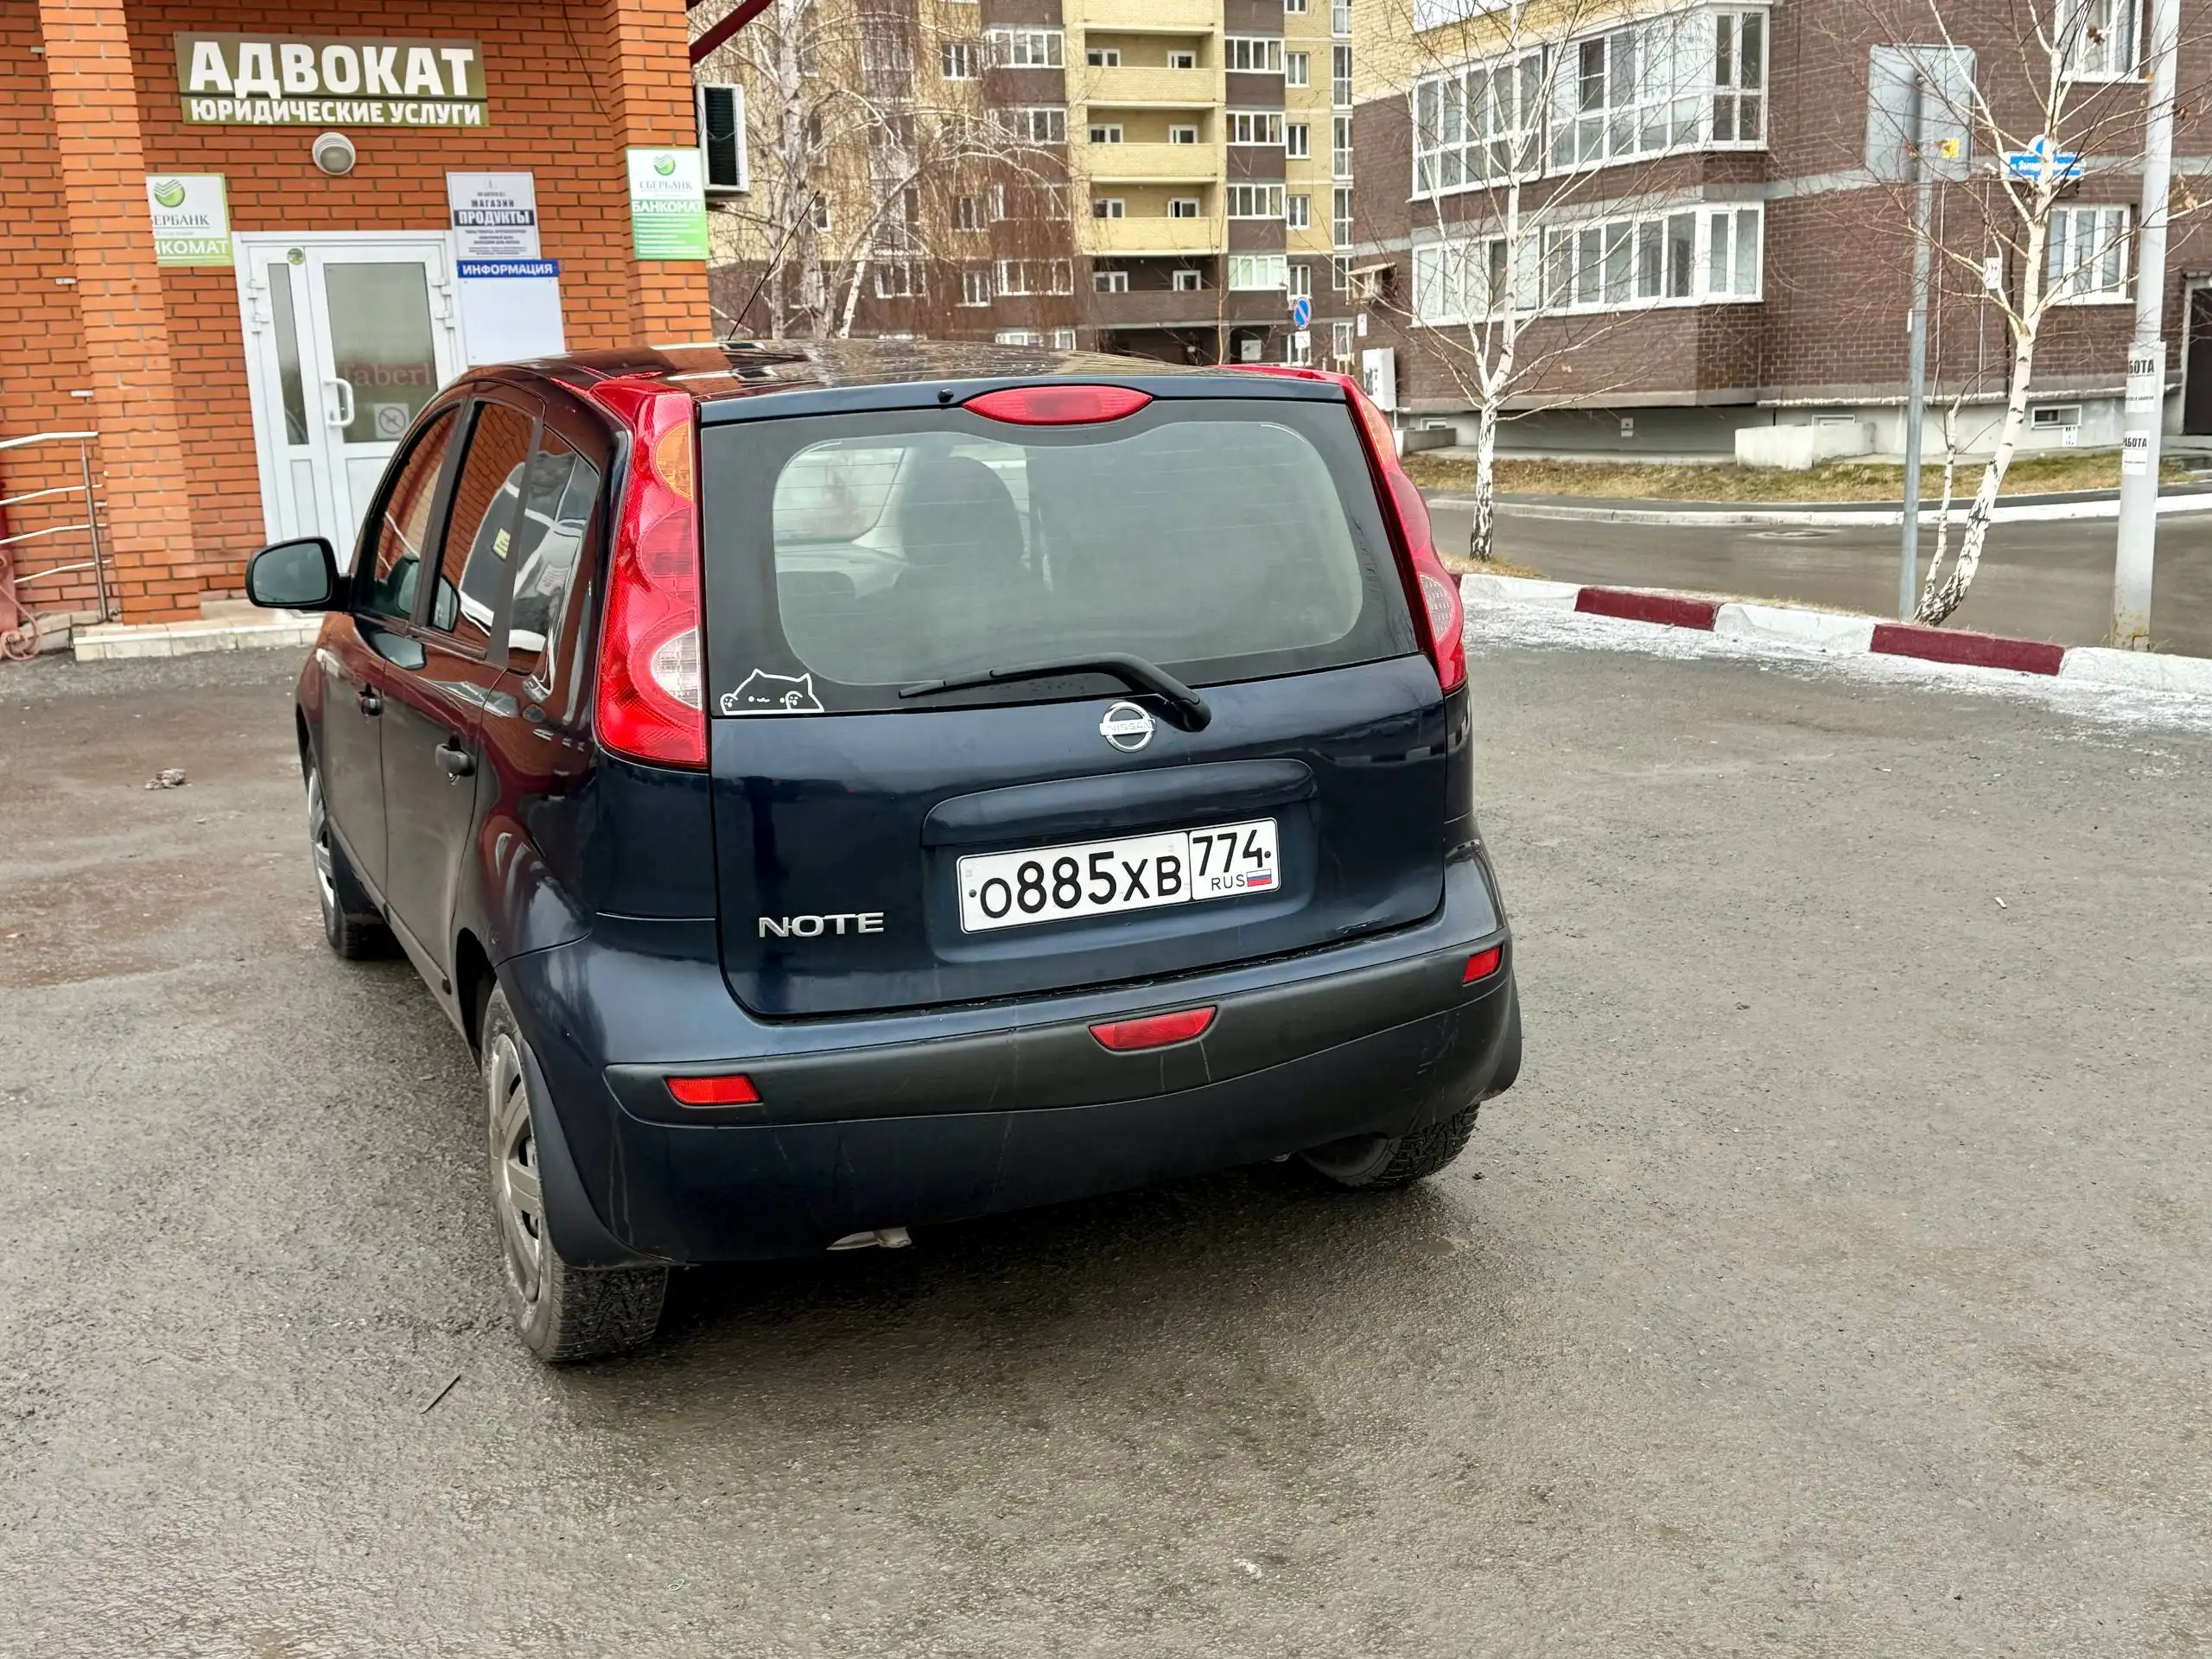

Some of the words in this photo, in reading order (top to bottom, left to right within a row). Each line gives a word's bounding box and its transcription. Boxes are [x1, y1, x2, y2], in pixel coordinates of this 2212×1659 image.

[189, 41, 474, 99] АДВОКАТ
[190, 99, 385, 124] ЮРИДИЧЕСКИЕ
[391, 103, 481, 125] УСЛУГИ
[639, 180, 692, 189] СБЕРБАНК
[632, 200, 703, 213] БАНКОМАТ
[153, 214, 210, 226] ЕРБАНК
[458, 210, 531, 226] ПРОДУКТЫ
[462, 264, 554, 276] ИНФОРМАЦИЯ
[1106, 721, 1152, 733] NISSAN
[1192, 830, 1263, 876] 774
[1211, 876, 1245, 892] RUS
[759, 912, 884, 938] NOTE
